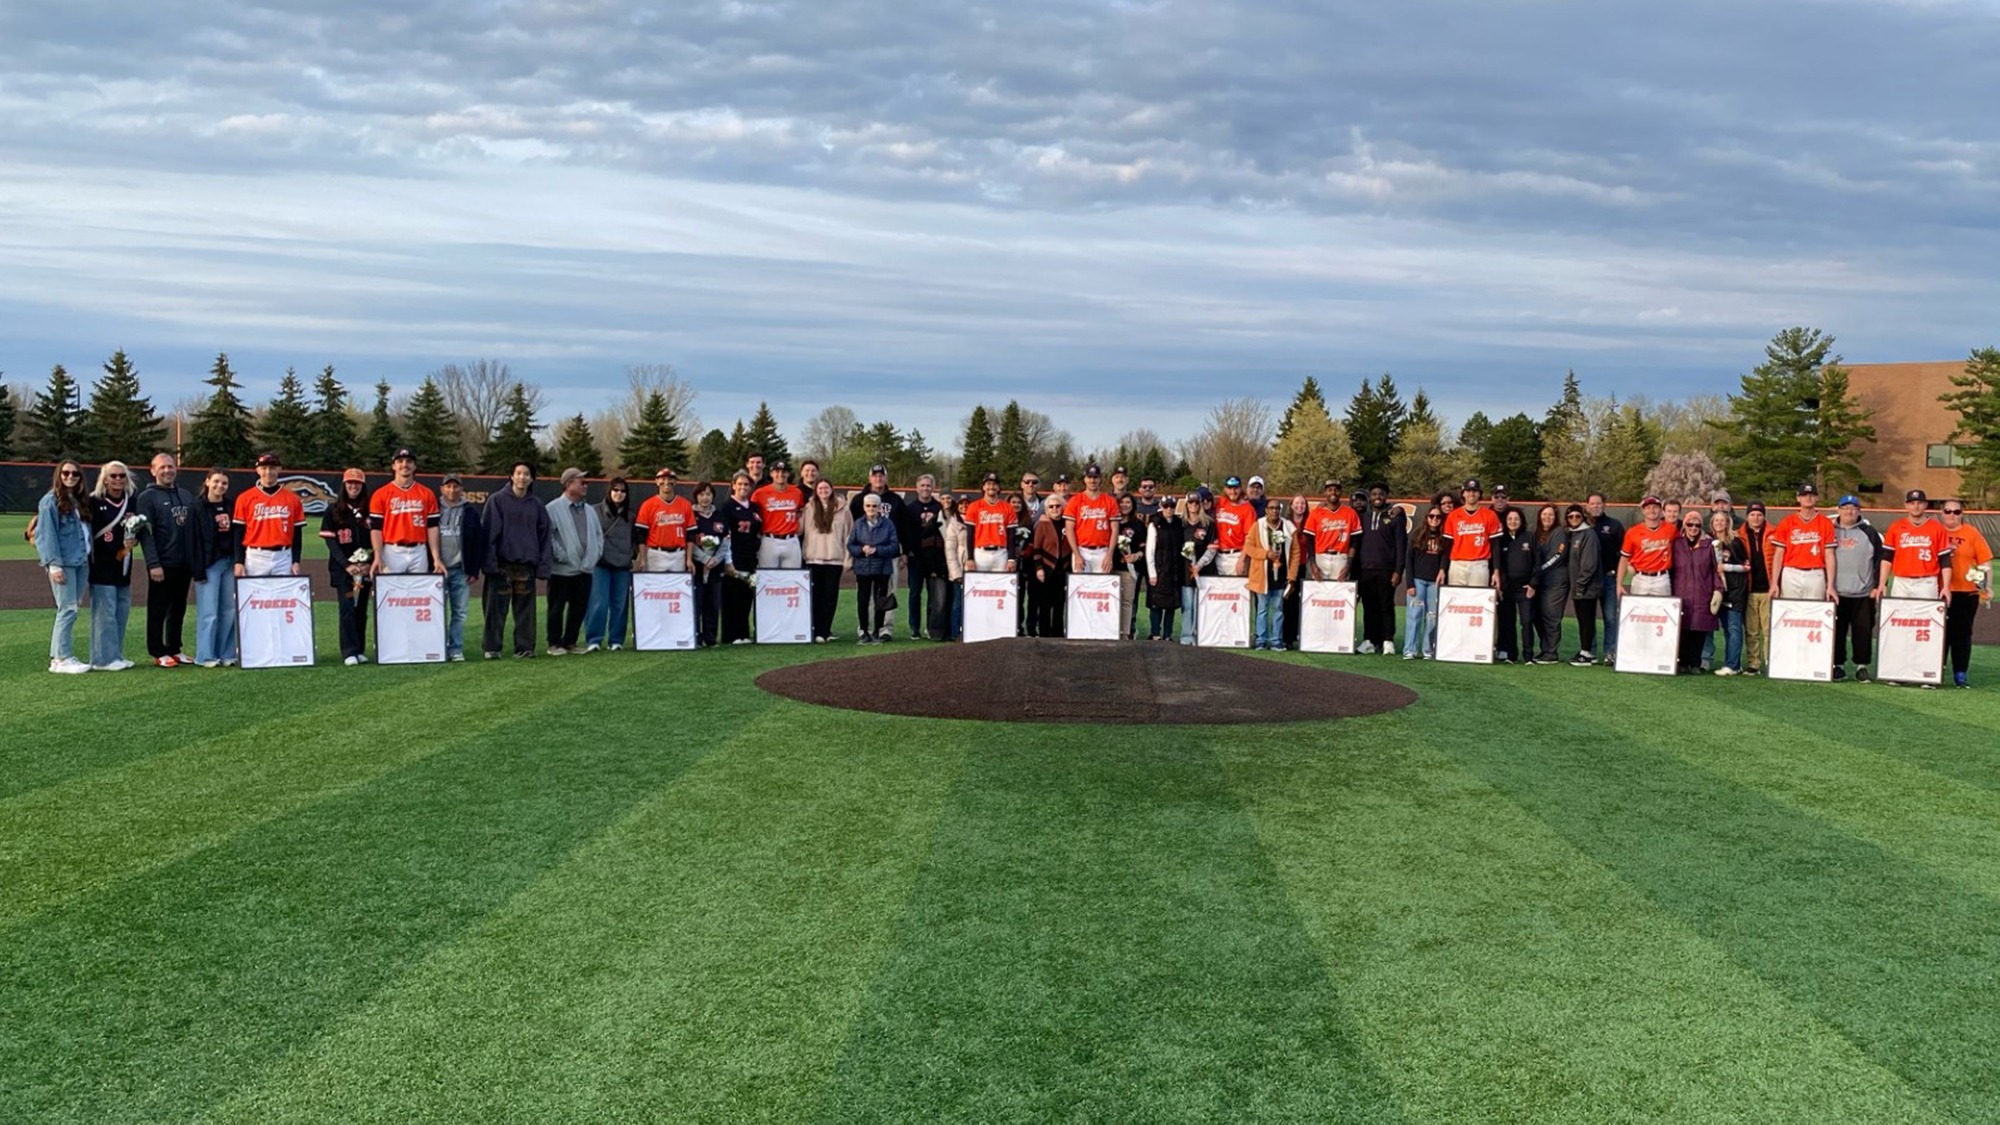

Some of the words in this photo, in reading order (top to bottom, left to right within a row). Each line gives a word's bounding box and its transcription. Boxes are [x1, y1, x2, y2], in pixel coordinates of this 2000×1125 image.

[390, 496, 424, 514] Tigers
[766, 497, 797, 511] Tigers
[254, 502, 291, 520] Tigers
[979, 510, 1005, 524] Tigers
[1081, 504, 1107, 519] Tigers
[1216, 507, 1240, 525] Tigers
[412, 515, 425, 527] 22
[656, 510, 685, 525] Tigers
[1096, 520, 1108, 530] 24
[1321, 517, 1349, 532] Tigers
[1458, 521, 1485, 535] Tigers
[1791, 528, 1820, 545] Tigers
[1901, 532, 1932, 548] Tigers
[1641, 538, 1670, 552] Tigers
[1918, 549, 1932, 562] 25
[643, 591, 680, 600] TIGERS
[764, 587, 799, 596] TIGERS
[972, 589, 1007, 597] TIGERS
[1076, 591, 1110, 600] TIGERS
[250, 598, 297, 609] TIGERS
[387, 597, 431, 607] TIGERS
[669, 602, 681, 614] 12
[787, 596, 799, 608] 37
[996, 599, 1004, 610] 2
[1096, 601, 1110, 613] 24
[1231, 602, 1237, 613] 4
[1311, 599, 1346, 607] TIGERS
[415, 608, 431, 622] 22
[1333, 609, 1344, 620] 10
[1447, 605, 1484, 614] TIGERS
[285, 610, 294, 624] 5
[1629, 614, 1668, 624] TIGERS
[1782, 618, 1823, 628] TIGERS
[1890, 618, 1931, 628] TIGERS
[1656, 624, 1664, 637] 3
[1807, 630, 1822, 643] 44
[1915, 629, 1931, 642] 25
